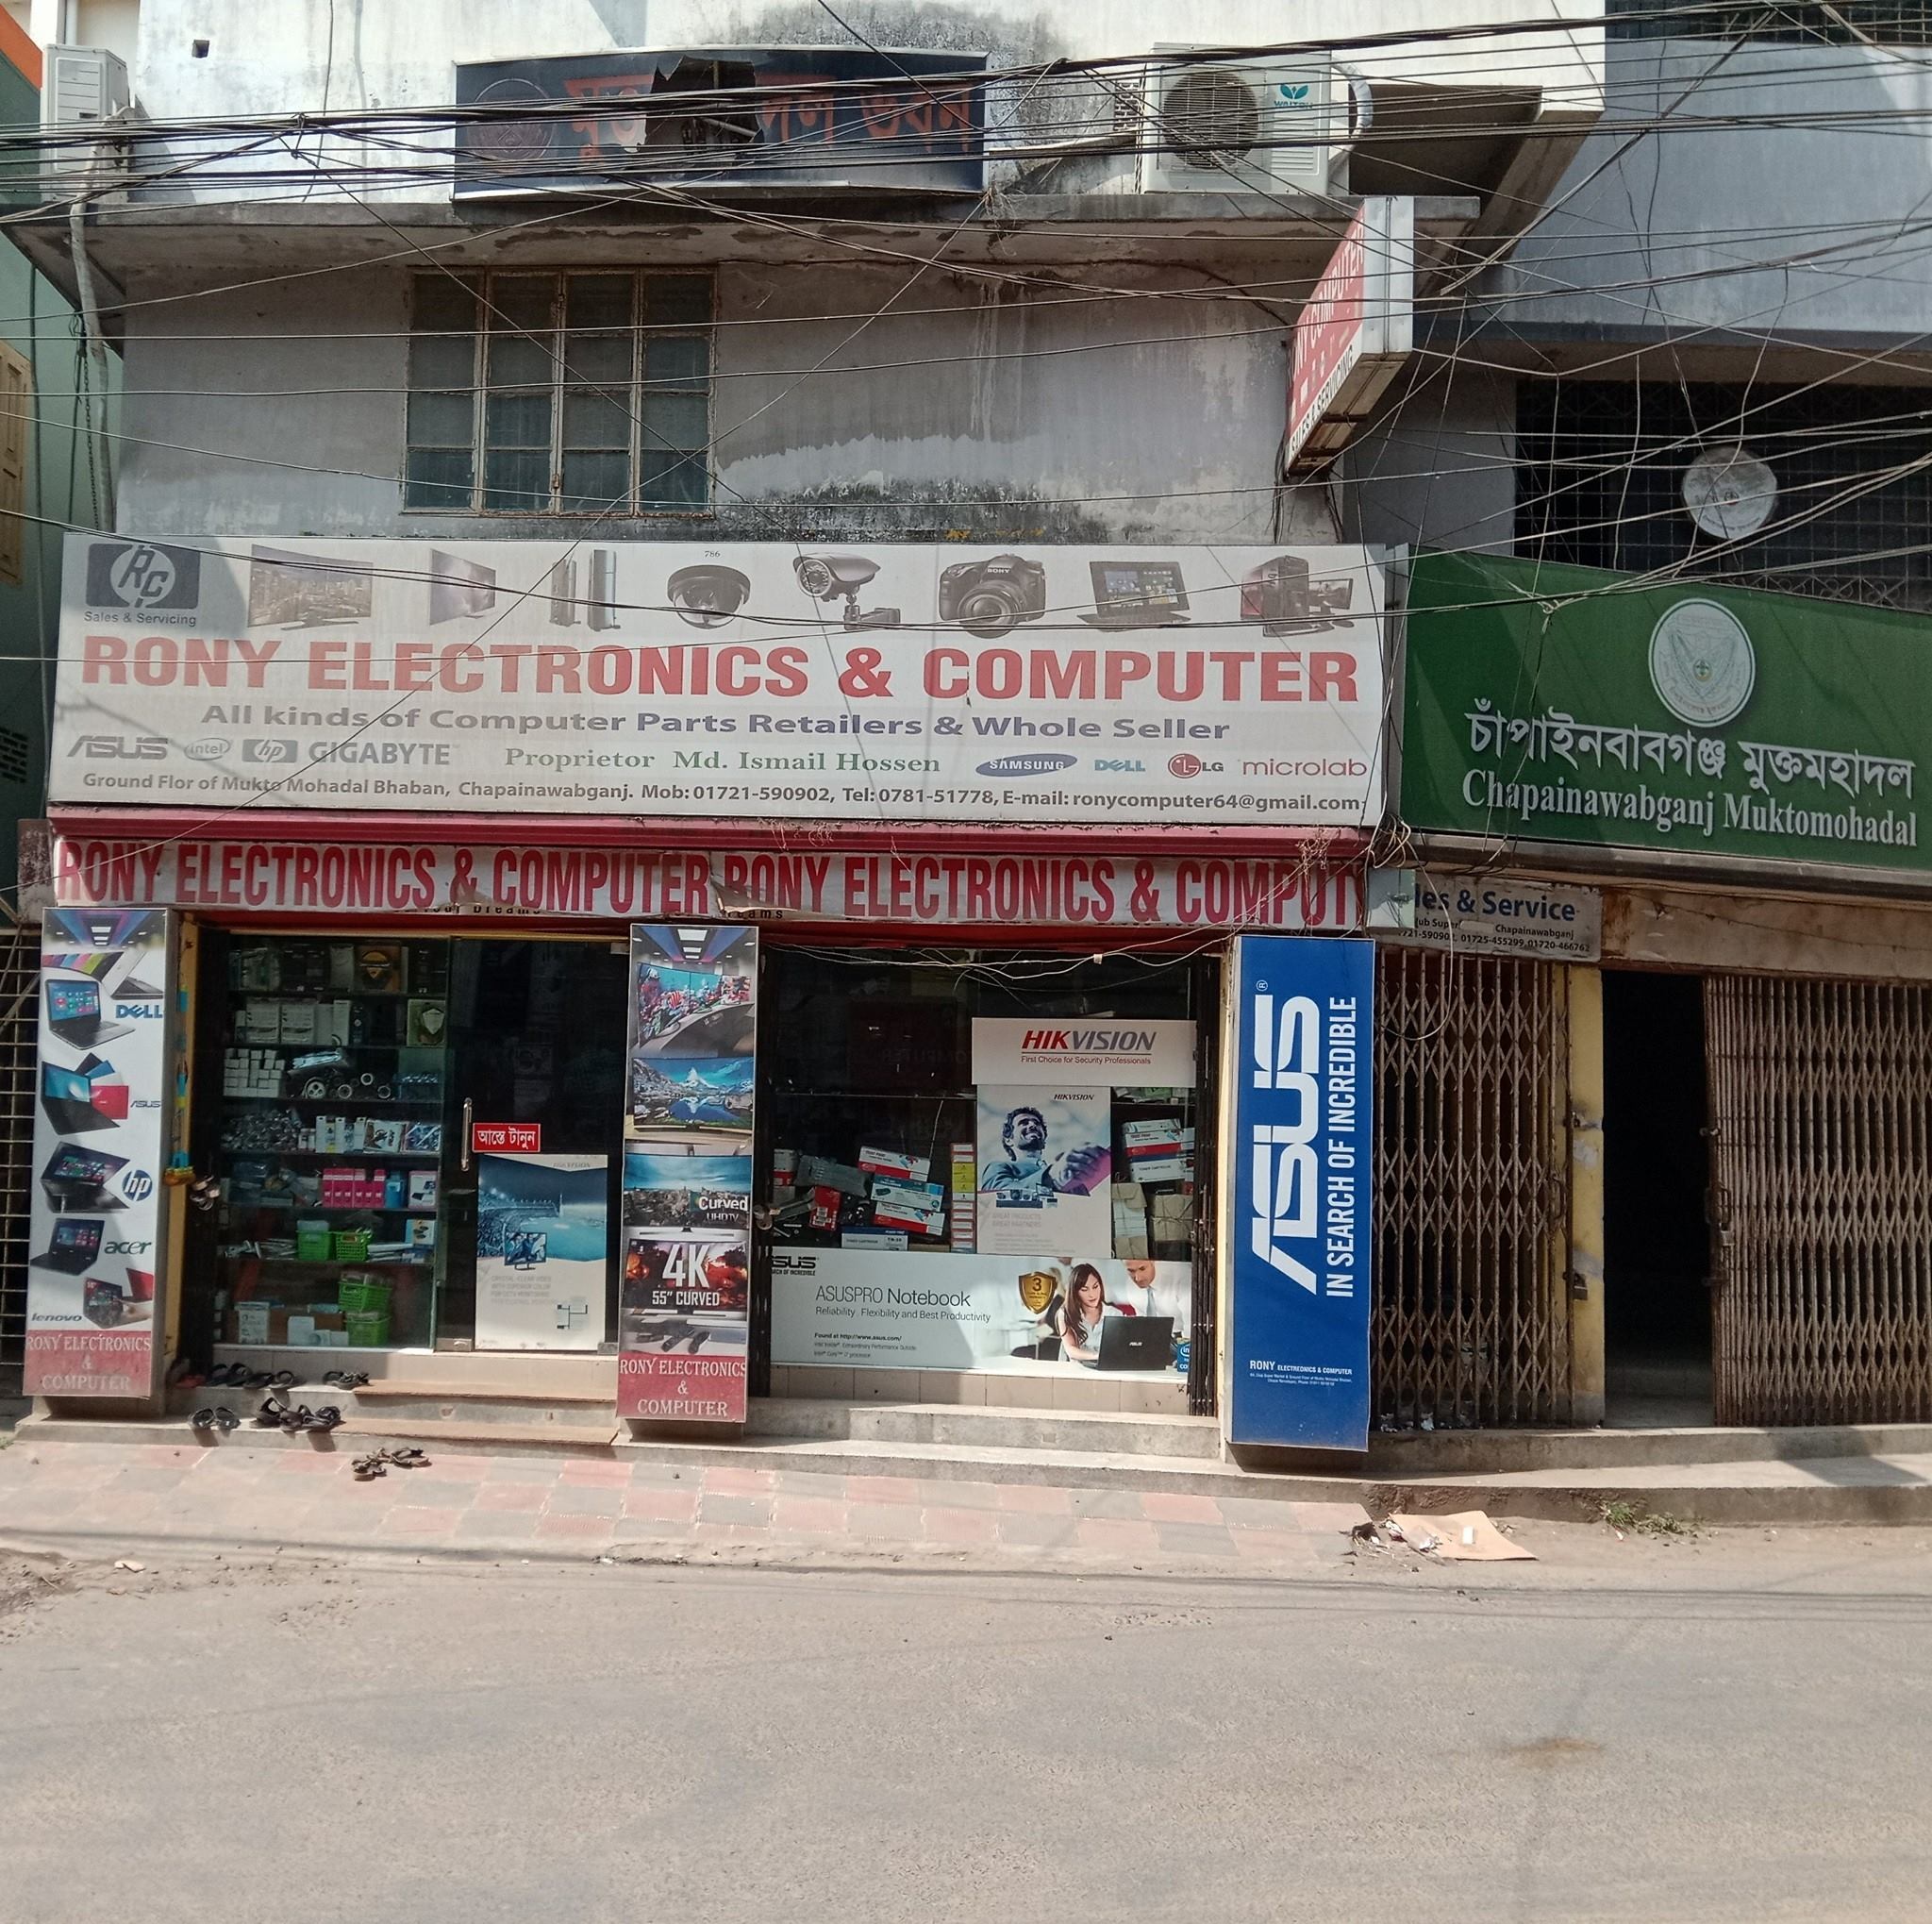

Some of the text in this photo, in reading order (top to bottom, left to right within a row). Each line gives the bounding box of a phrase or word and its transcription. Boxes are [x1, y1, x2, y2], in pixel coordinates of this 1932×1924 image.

[704, 550, 721, 559] 786
[84, 611, 196, 627] Sales & Servicing
[81, 636, 1358, 702] RONY ELECTRONICS & COMPUTER
[201, 704, 1230, 741] All kinds of Computer Parts Retailers & Whole Seller
[67, 735, 169, 761] ASUS
[258, 740, 283, 763] hp
[308, 741, 450, 765] GIGABYTE
[1464, 697, 1916, 800] চাঁপাইনবাবগঞ্জ মুক্তমহাদল
[505, 747, 941, 773] Proprietor Md. Ismail Hossen
[989, 760, 1064, 771] SAMSUNG
[1094, 759, 1146, 772] DELL
[1202, 761, 1224, 772] LG
[1242, 758, 1367, 776] microlab
[83, 772, 153, 789] Ground
[158, 775, 193, 790] Flor
[198, 775, 219, 790] of
[222, 777, 281, 793] Mukto
[287, 778, 368, 794] Mohadal
[374, 779, 451, 797] Bhaban,
[458, 781, 634, 801] Chapainawabganj.
[1462, 768, 1918, 847] Chapainawabganj Muktomohadal
[58, 841, 164, 902] RONY
[175, 844, 435, 910] ELECTRONICS
[450, 849, 478, 907] &
[492, 848, 708, 916] COMPUTER
[724, 853, 830, 912] RONY
[844, 855, 1115, 923] ELECTRONICS
[1130, 859, 1160, 924] &
[1457, 889, 1476, 913] &
[1482, 891, 1575, 922] Service
[1495, 924, 1574, 941] Chapainawabganj
[116, 1004, 162, 1019] DELL
[1021, 1030, 1157, 1051] HIKVISION
[1021, 1055, 1151, 1065] First Choice for Security Professionals
[477, 1127, 536, 1149] আস্তে টানুন
[1252, 995, 1320, 1296] ASUS
[1326, 996, 1357, 1297] IN SEARCH OF INCREDIBLE
[124, 1169, 152, 1201] hp
[698, 1195, 748, 1212] Curved
[104, 1241, 152, 1255] acer
[662, 1244, 709, 1287] 4K
[771, 1255, 816, 1269] SUS
[1032, 1277, 1041, 1292] 3
[676, 1291, 720, 1306] CURVED
[815, 1285, 971, 1308] ASUSPRO Notebook
[31, 1313, 82, 1322] lenovo
[815, 1307, 991, 1324] Reliability Flexibility and Best Productivity
[27, 1334, 151, 1351] RONY ELECTRONICS
[81, 1353, 93, 1370] &
[620, 1357, 745, 1377] RONY ELECTRONICS
[1249, 1360, 1275, 1371] RONY
[42, 1374, 130, 1391] COMPUTER
[677, 1380, 689, 1395] &
[638, 1398, 727, 1416] COMPUTER
